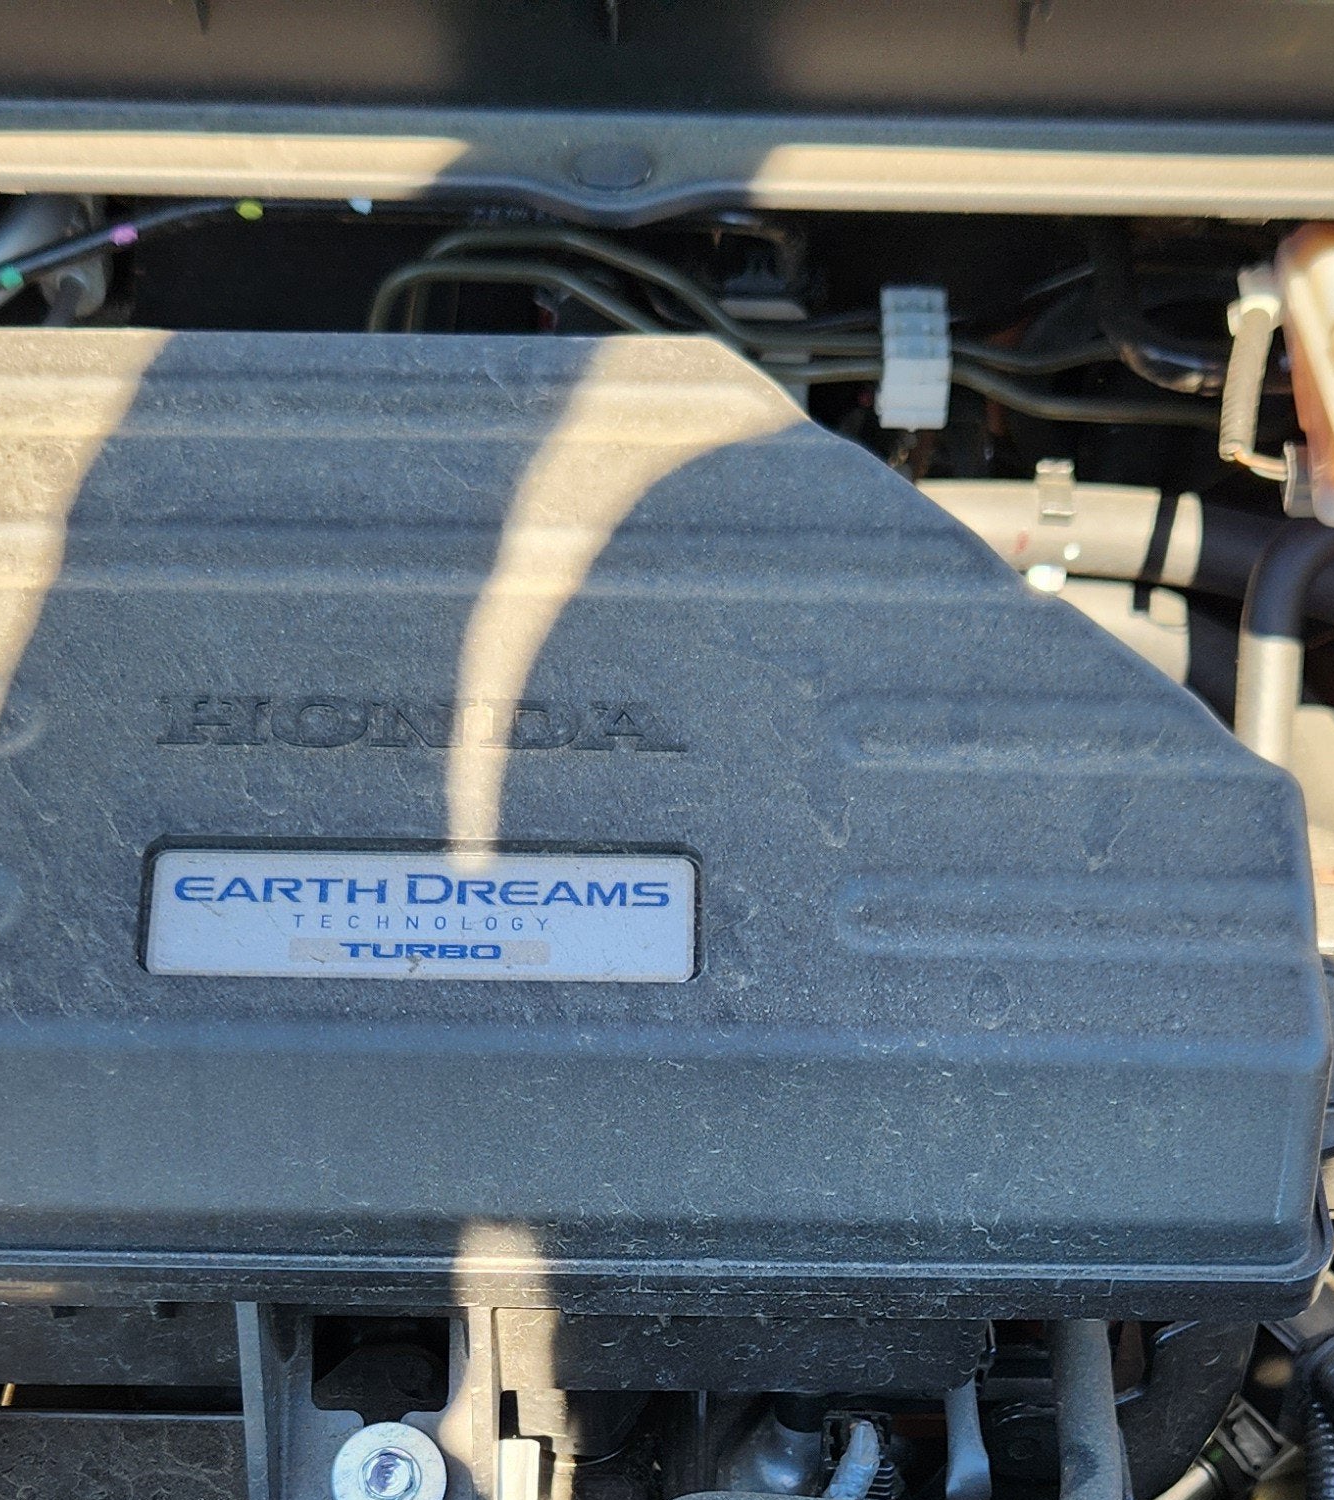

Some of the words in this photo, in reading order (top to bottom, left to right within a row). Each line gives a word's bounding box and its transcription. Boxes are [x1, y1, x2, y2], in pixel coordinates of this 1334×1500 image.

[157, 696, 689, 754] HONDA
[174, 876, 387, 906] EARTH
[406, 873, 670, 908] DREAMS
[292, 913, 552, 933] TECHNOLOGY
[338, 942, 502, 962] TURBO
